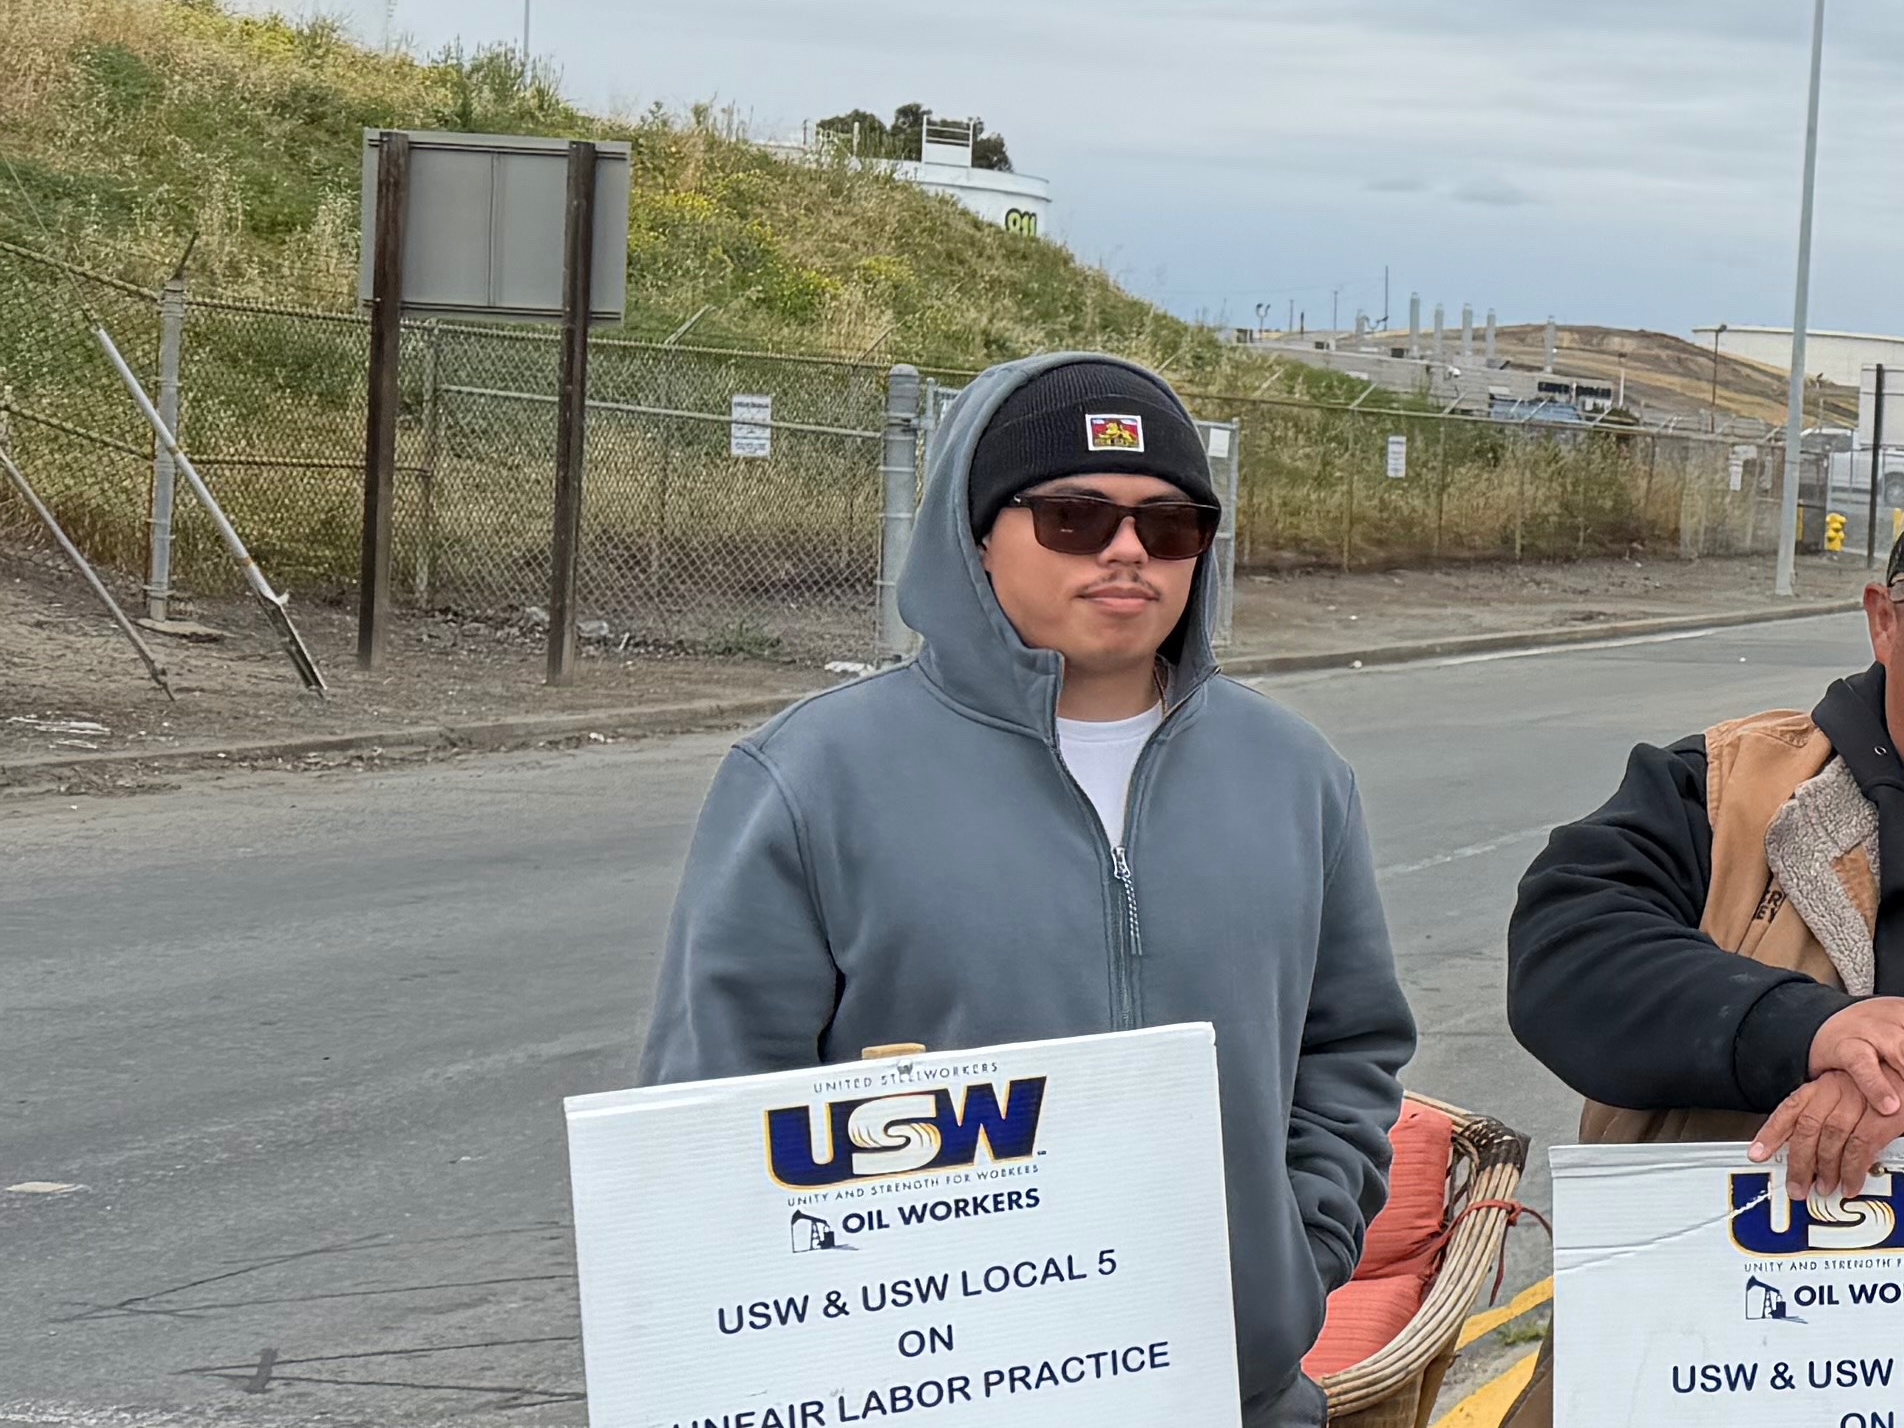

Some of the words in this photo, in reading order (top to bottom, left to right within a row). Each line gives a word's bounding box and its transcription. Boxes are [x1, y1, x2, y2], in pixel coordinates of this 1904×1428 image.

[814, 1077, 872, 1093] UNITED
[763, 1076, 1048, 1189] USW
[842, 1209, 890, 1233] OIL
[898, 1188, 1040, 1225] WORKERS
[1744, 1262, 1783, 1272] UNITY
[1790, 1261, 1817, 1271] AND
[1824, 1259, 1890, 1269] STRENGTH
[718, 1295, 809, 1334] USW
[823, 1290, 850, 1318] &
[862, 1273, 948, 1311] USW
[962, 1255, 1087, 1296] LOCAL
[1098, 1249, 1116, 1275] 5
[1794, 1285, 1839, 1306] OIL
[898, 1324, 953, 1357] ON
[838, 1376, 971, 1422] LABOR
[984, 1341, 1170, 1398] PRACTICE
[1673, 1363, 1758, 1393] USW
[1770, 1362, 1796, 1390] &
[1809, 1358, 1893, 1388] USW
